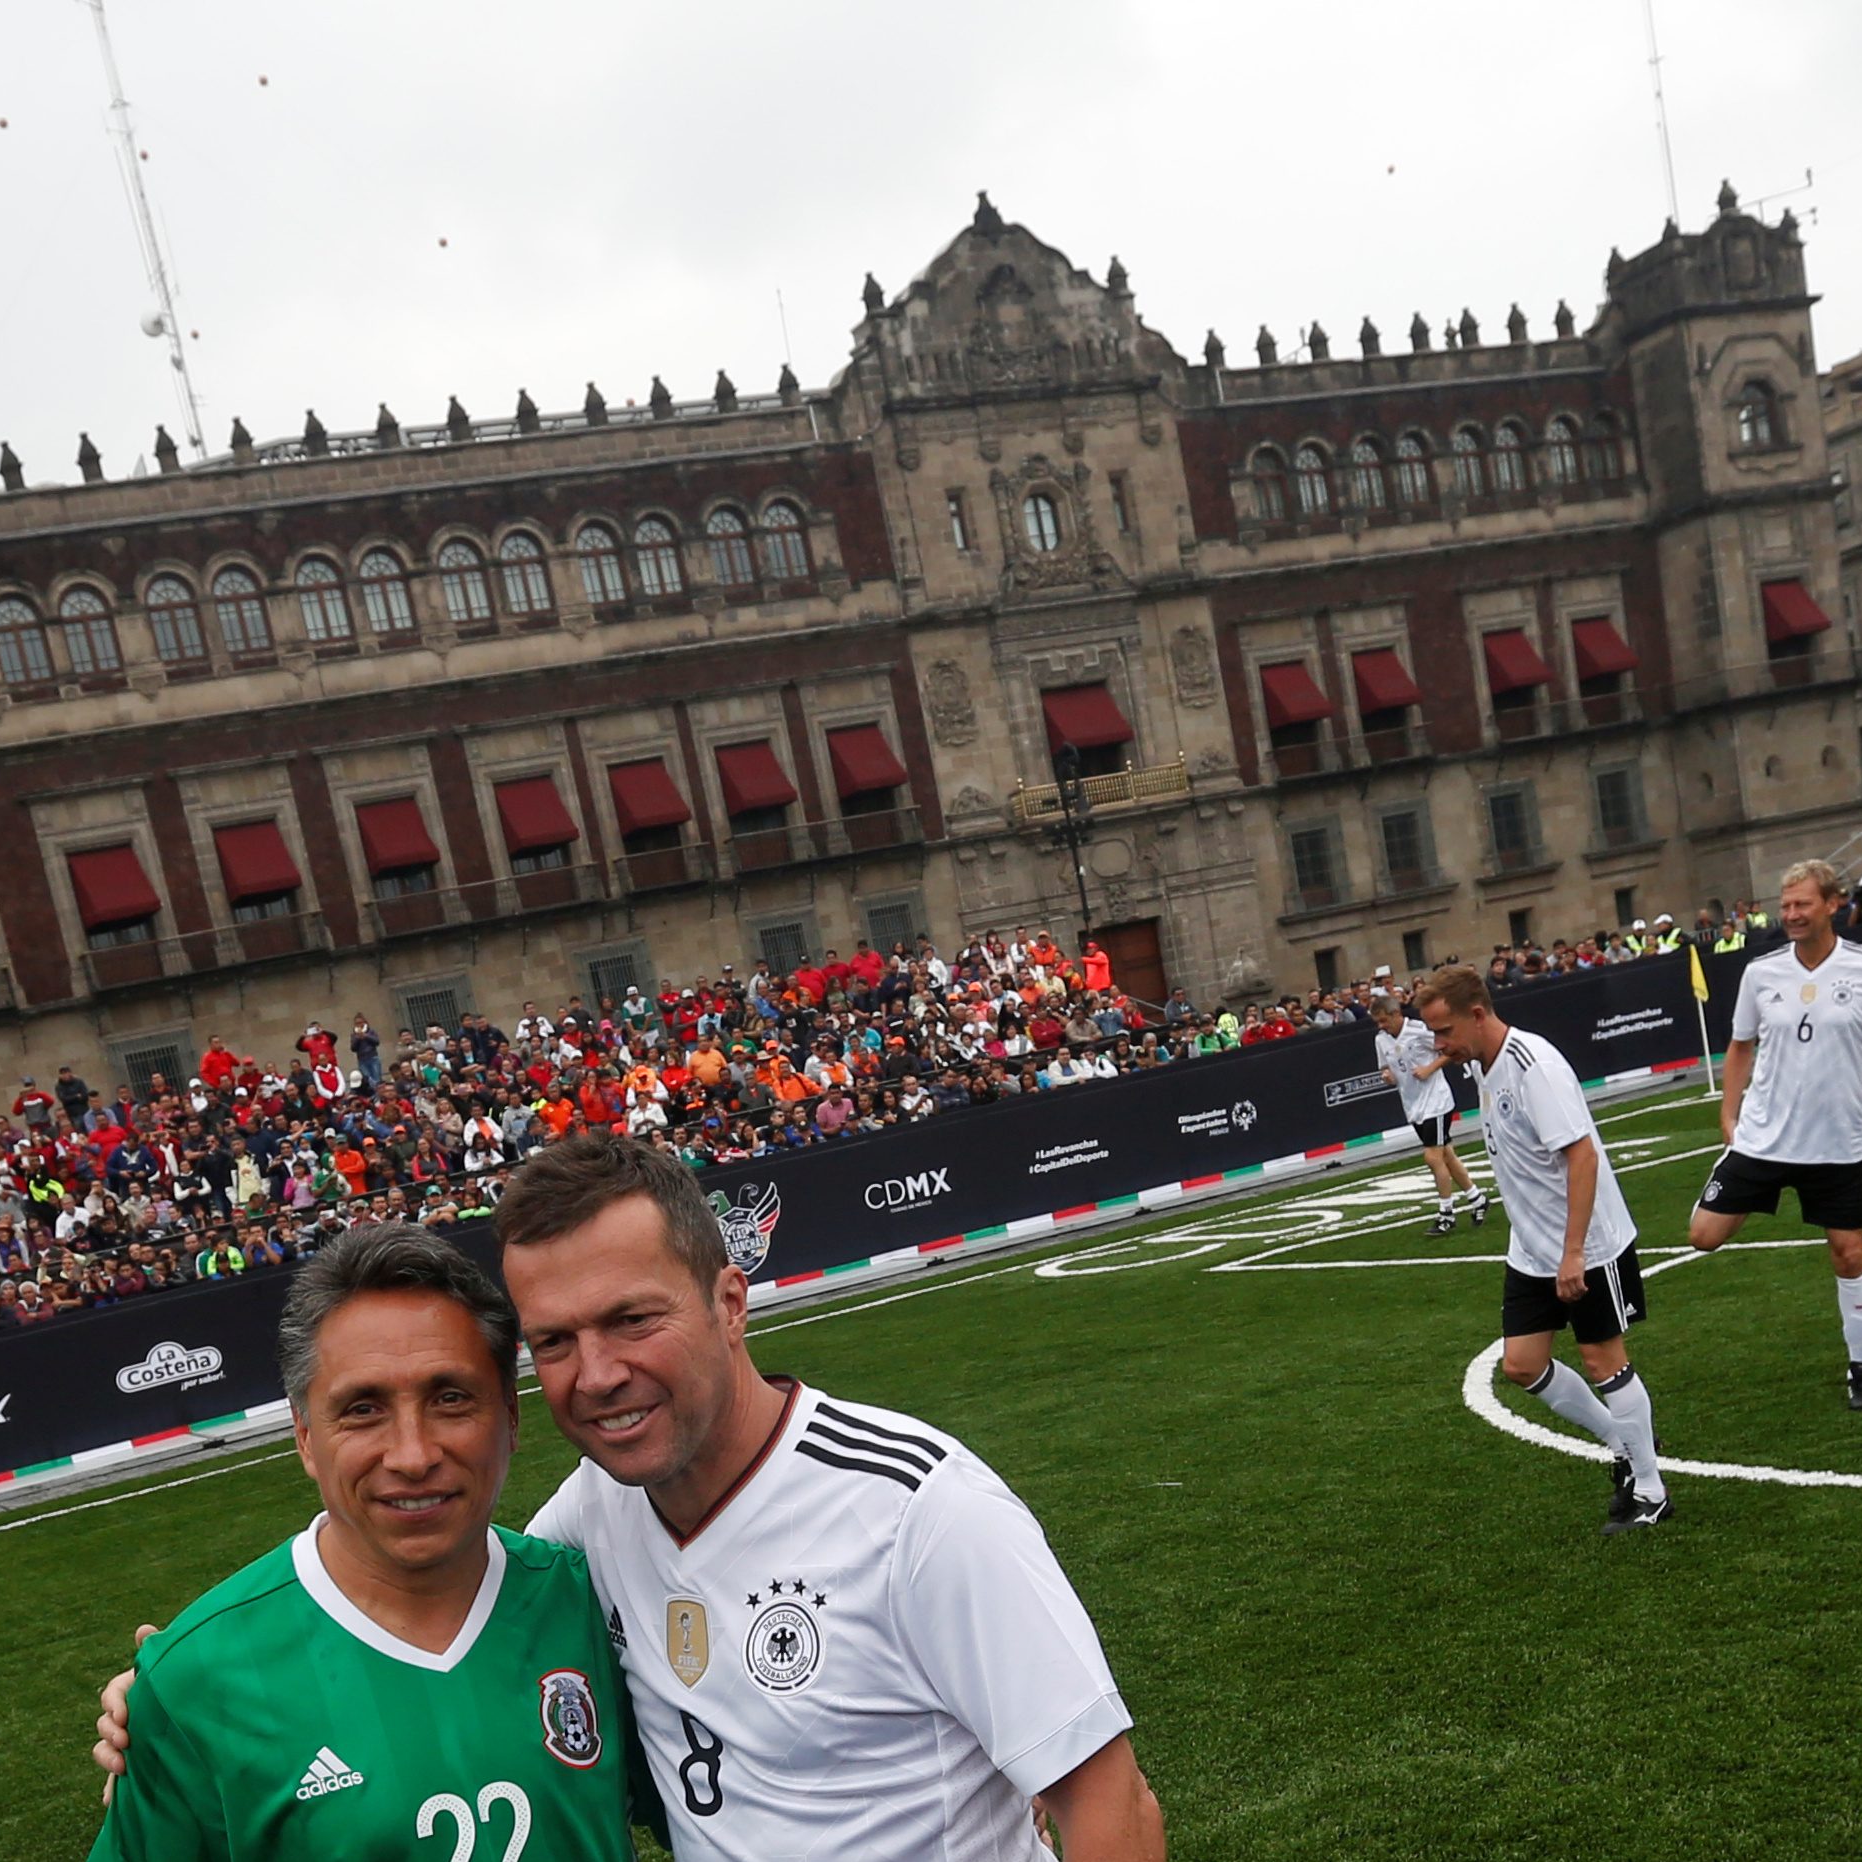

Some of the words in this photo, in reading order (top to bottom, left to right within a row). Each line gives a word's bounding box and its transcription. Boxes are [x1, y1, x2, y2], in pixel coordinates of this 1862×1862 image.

[1797, 1012, 1813, 1043] 6
[1397, 1058, 1407, 1074] 5
[864, 1167, 952, 1210] CDMX
[127, 1354, 212, 1386] Costeña
[157, 1350, 176, 1363] La
[763, 1613, 805, 1632] DEUTSCHER
[679, 1710, 723, 1817] 8
[296, 1771, 364, 1801] adidas
